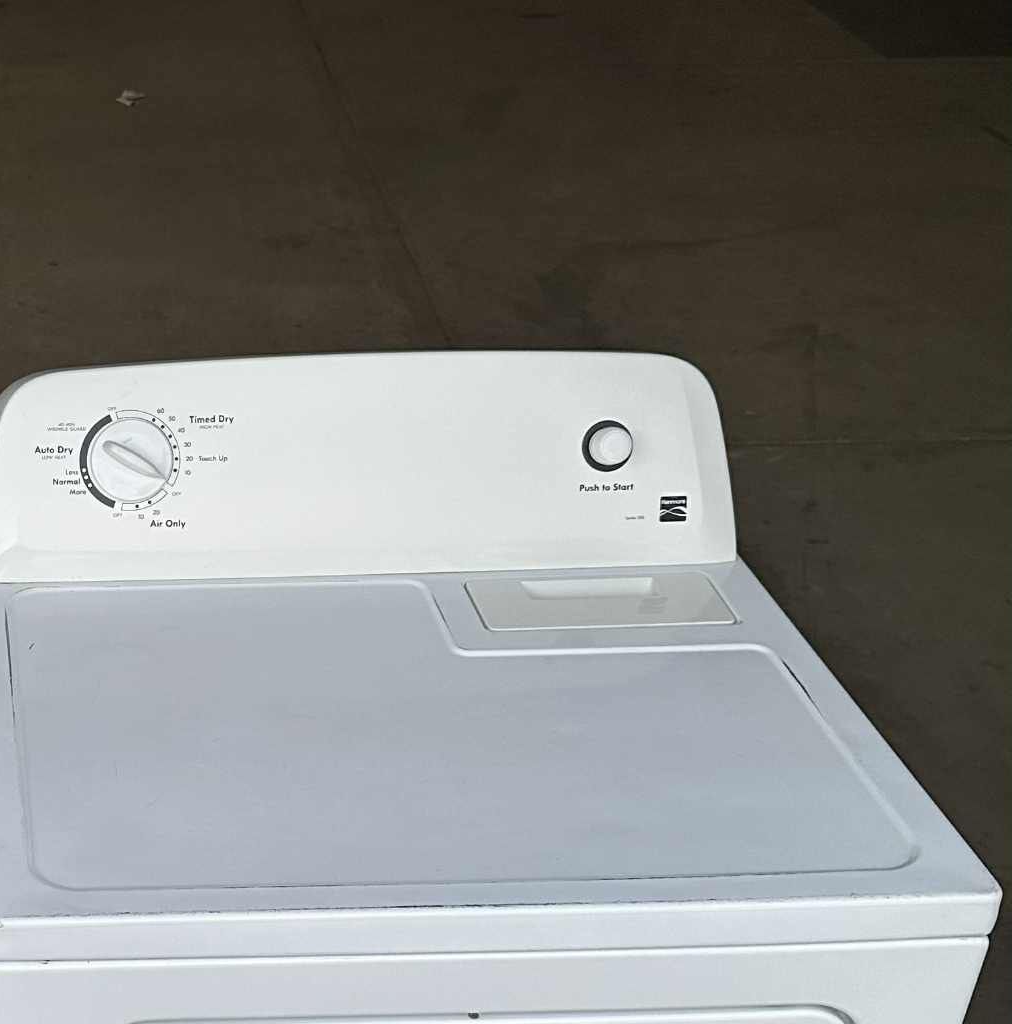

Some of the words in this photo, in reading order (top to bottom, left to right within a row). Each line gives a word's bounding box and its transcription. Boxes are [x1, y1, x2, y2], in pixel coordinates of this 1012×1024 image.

[189, 414, 216, 424] Timed
[218, 414, 235, 424] Dry
[34, 445, 55, 454] Auto
[57, 445, 74, 455] Dry
[218, 455, 229, 463] Up
[52, 477, 81, 486] Normal
[579, 484, 600, 492] Push
[612, 483, 634, 491] Start
[149, 519, 163, 528] Air
[165, 519, 186, 528] Only
